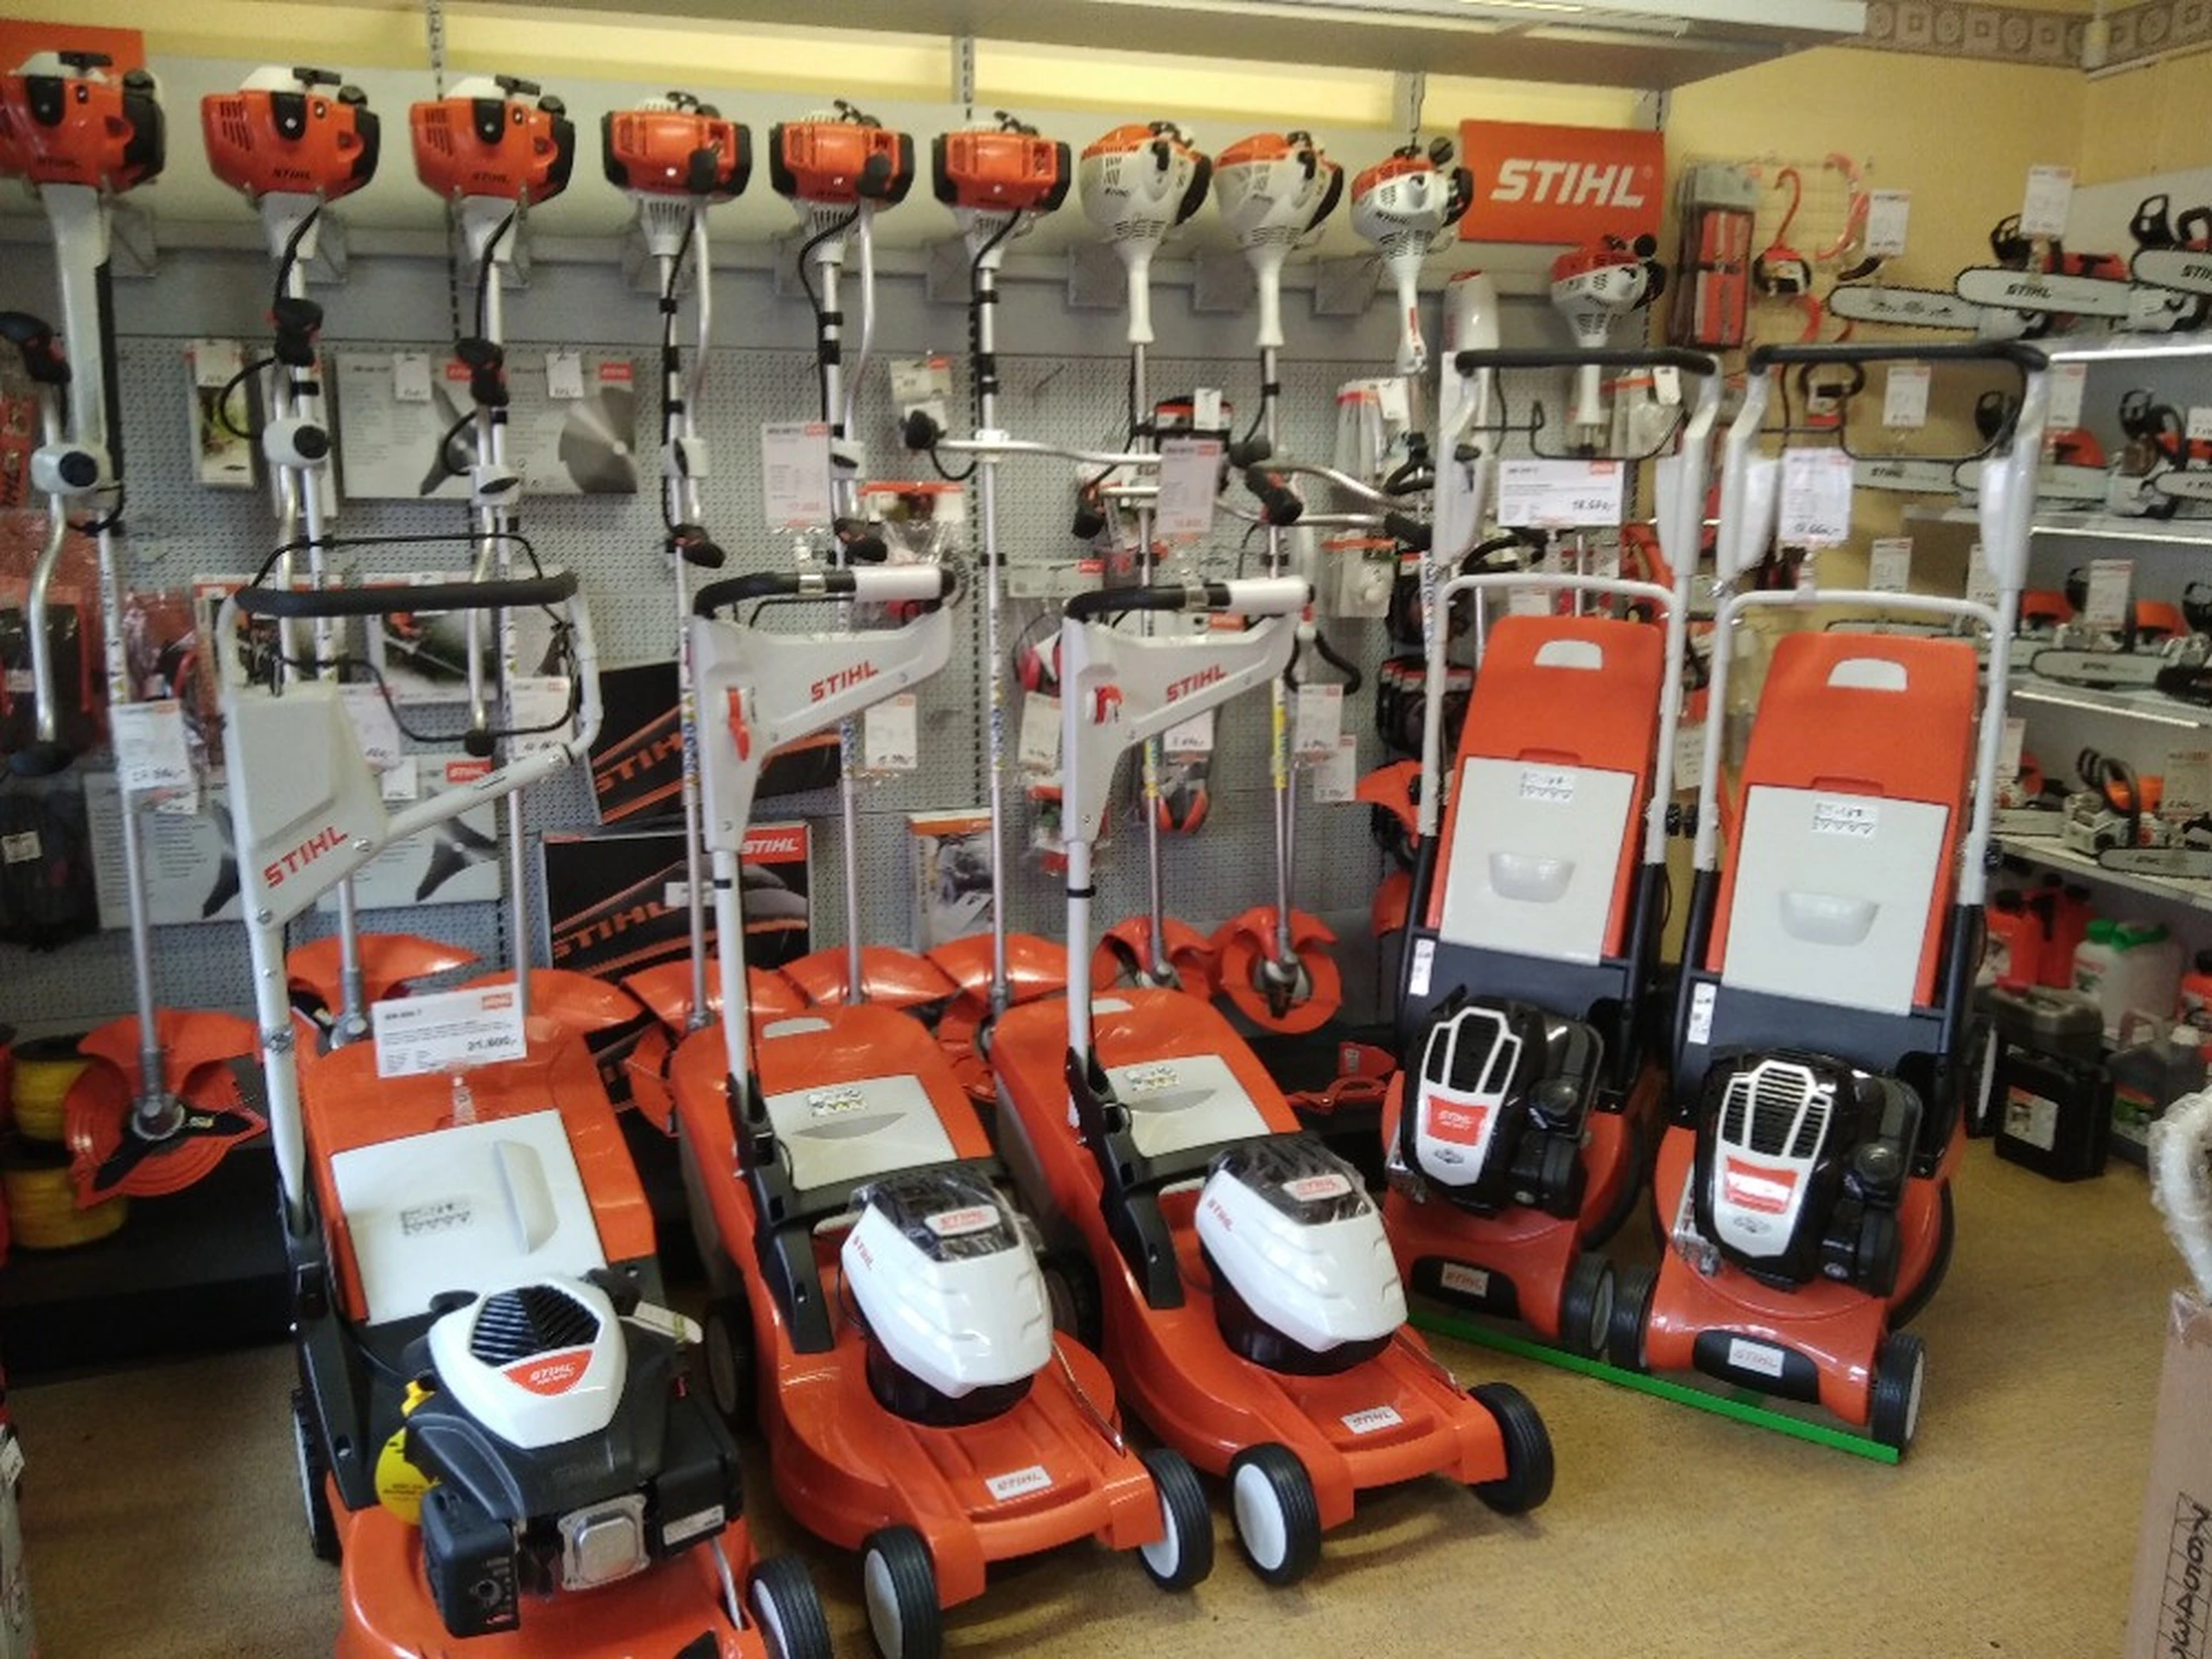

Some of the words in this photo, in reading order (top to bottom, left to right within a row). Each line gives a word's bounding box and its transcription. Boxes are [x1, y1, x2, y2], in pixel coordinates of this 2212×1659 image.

[1490, 158, 1644, 207] STIHL
[2005, 283, 2052, 298] STIHL
[810, 660, 879, 702] STIHL
[1166, 664, 1227, 703] STIHL
[595, 734, 683, 793] STIH
[263, 826, 348, 888] STIHL
[741, 838, 799, 855] STIHL
[553, 901, 678, 959] STIHL
[1207, 1198, 1234, 1232] STIHL
[853, 1236, 874, 1270] STIHL
[1446, 1271, 1483, 1290] STIHL
[1734, 1347, 1777, 1368] STIHL
[1353, 1408, 1393, 1427] STIHL
[997, 1471, 1043, 1493] STIHL
